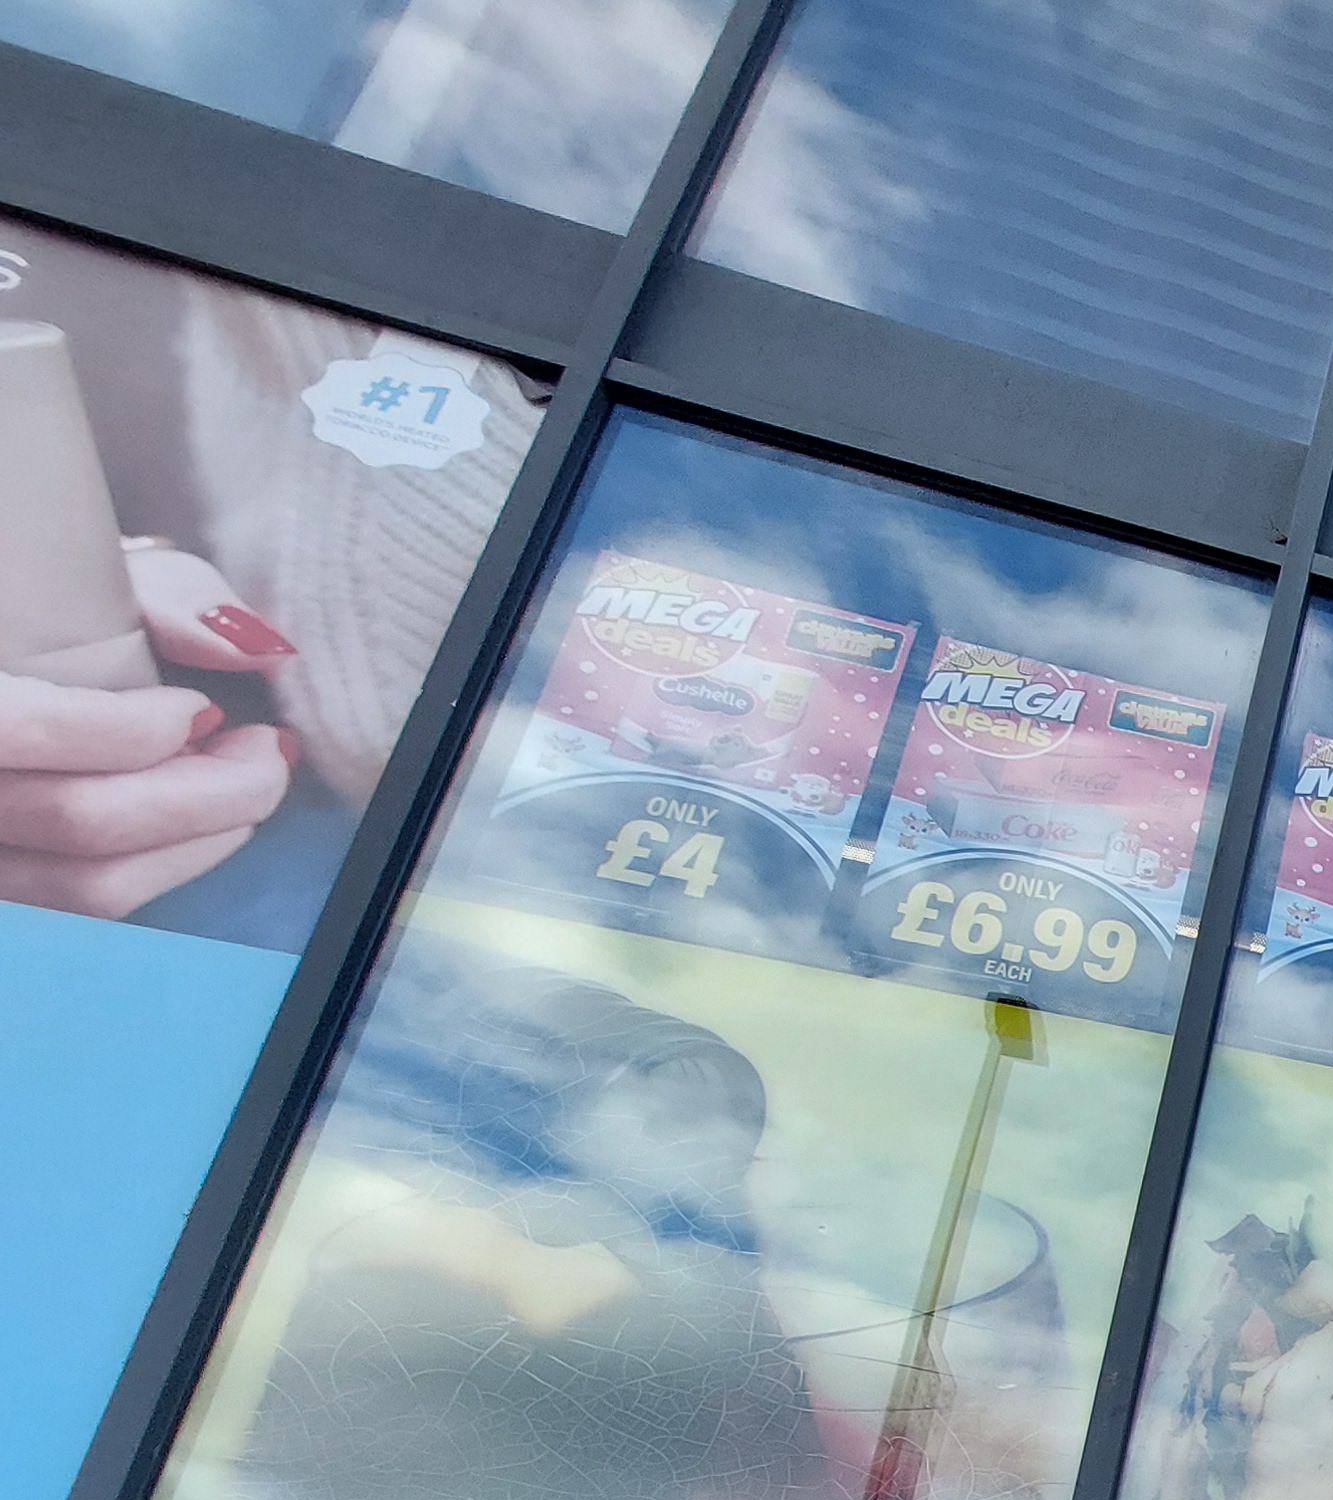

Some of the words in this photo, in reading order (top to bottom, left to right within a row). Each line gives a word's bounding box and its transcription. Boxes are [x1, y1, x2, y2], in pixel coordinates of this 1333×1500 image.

[360, 375, 452, 425] #1
[576, 586, 760, 642] MEGA
[595, 618, 720, 667] deals
[656, 674, 747, 710] Cushelle
[921, 671, 1086, 724] MEGA
[938, 701, 1053, 748] deals
[646, 796, 719, 828] ONLY
[1001, 815, 1078, 842] Coke
[597, 819, 725, 899] £4
[999, 870, 1065, 901] ONLY
[890, 880, 1139, 984] £6.99
[984, 959, 1033, 984] EACH
